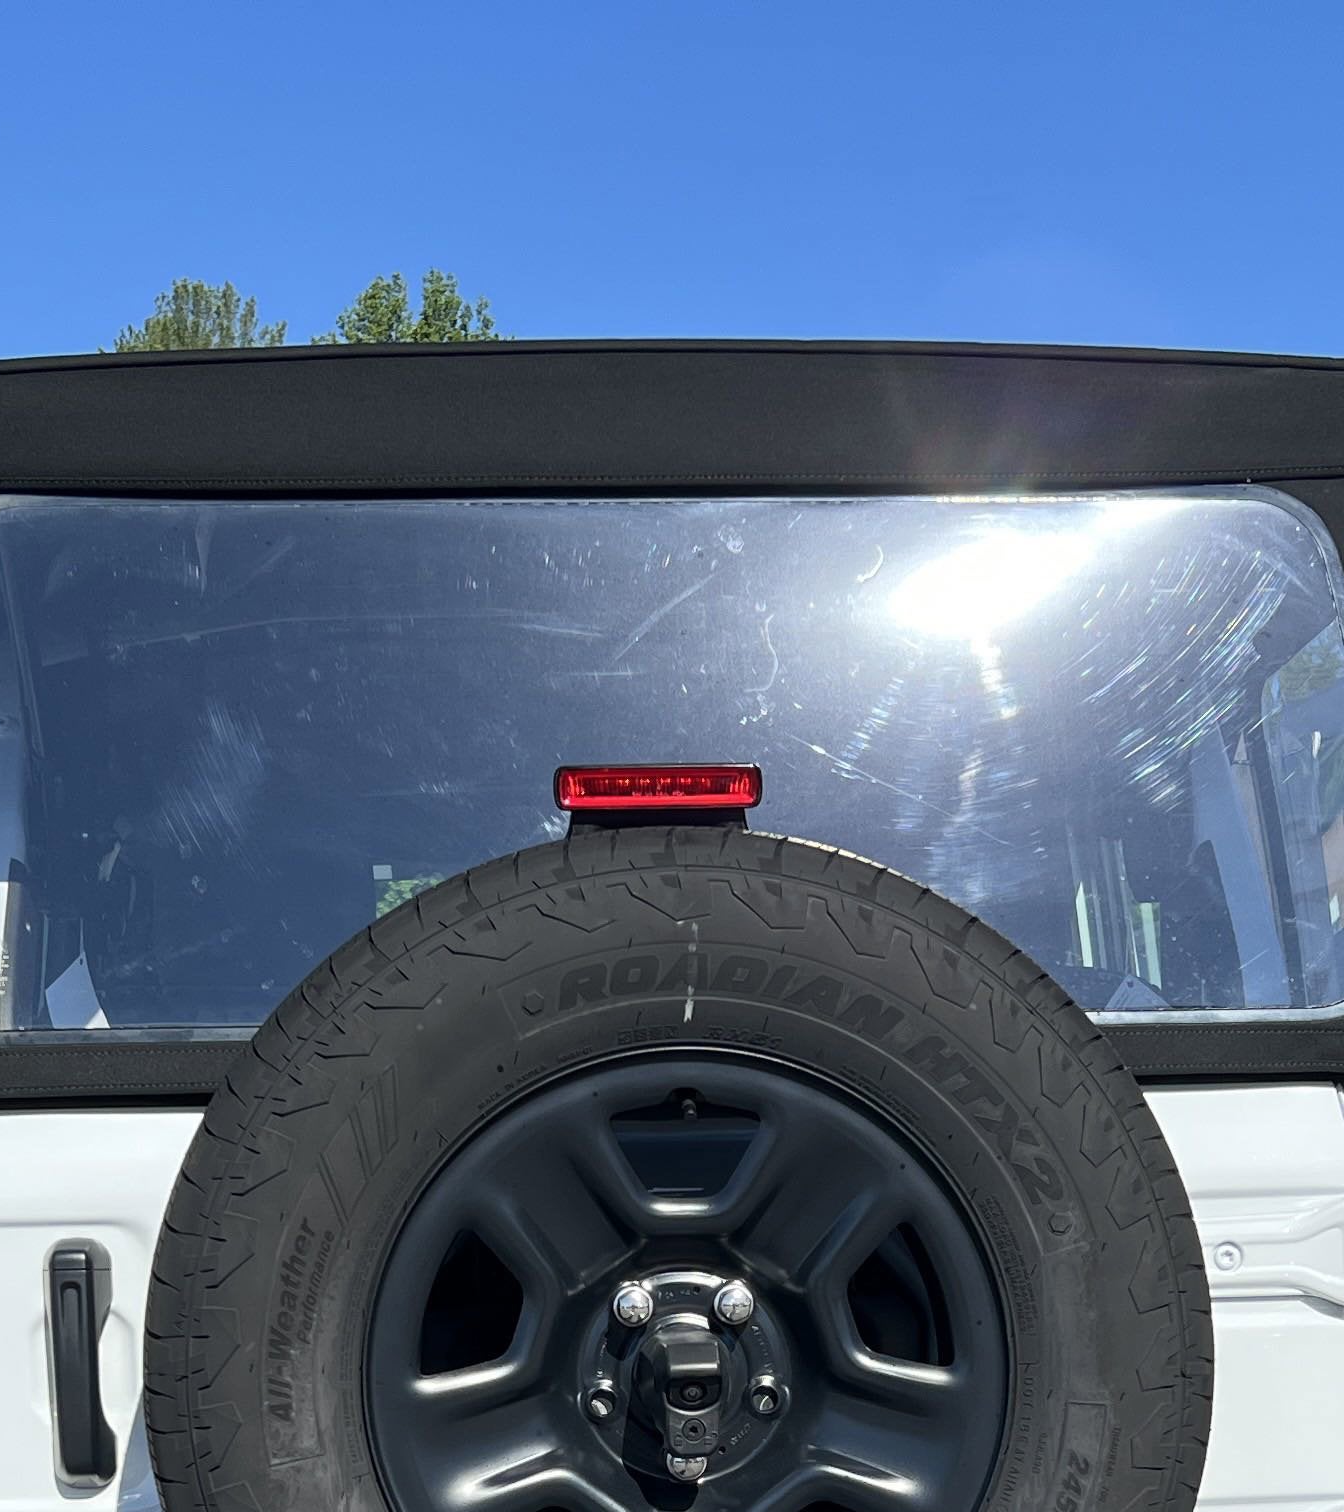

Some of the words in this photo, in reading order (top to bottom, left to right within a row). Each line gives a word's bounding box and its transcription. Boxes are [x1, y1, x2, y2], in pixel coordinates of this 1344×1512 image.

[558, 952, 908, 1036] ROADIAN
[905, 1035, 1064, 1205] HTX2
[267, 1218, 316, 1423] All-Weather
[297, 1229, 335, 1344] Performance
